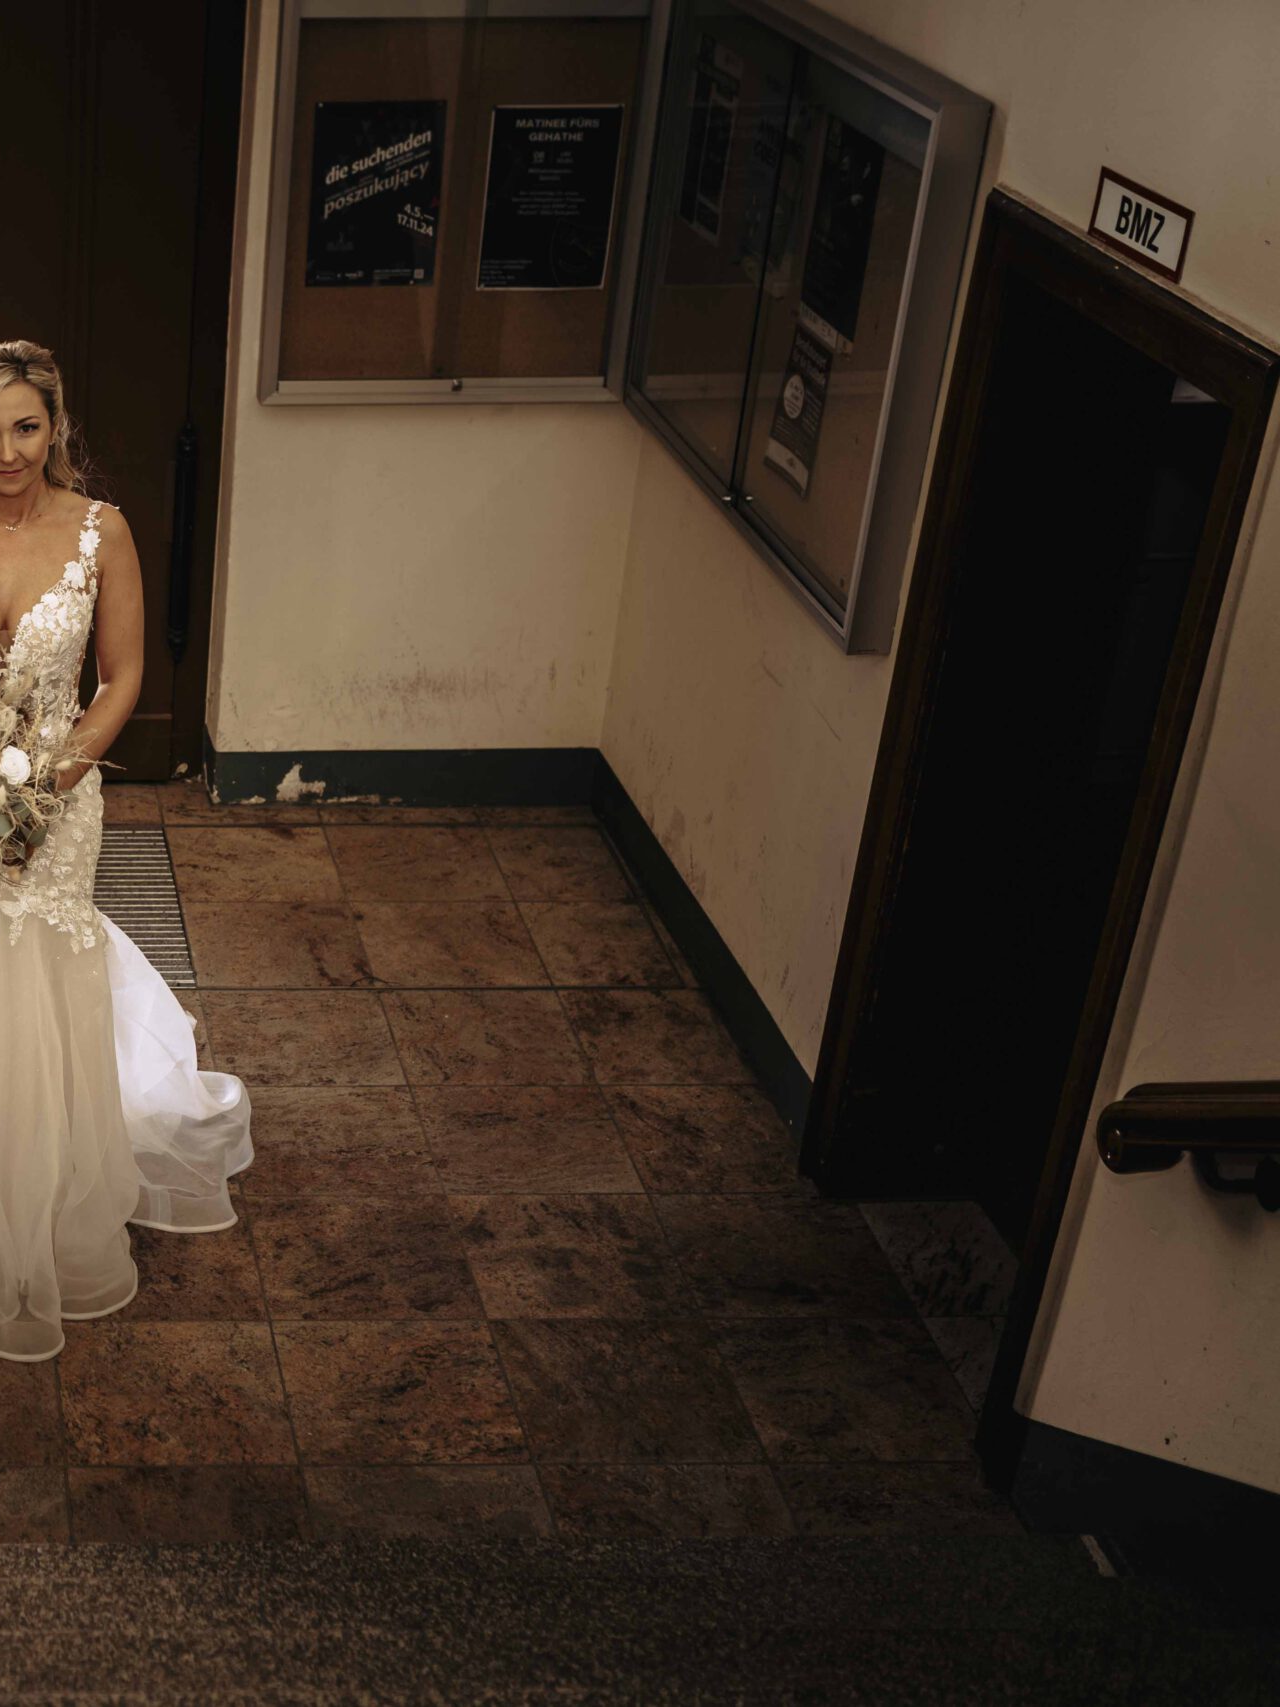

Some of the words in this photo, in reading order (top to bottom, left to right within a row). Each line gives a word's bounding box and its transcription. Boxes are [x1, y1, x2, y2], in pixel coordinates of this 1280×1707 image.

[515, 118, 568, 128] MATINEE
[569, 116, 600, 128] FÜRS
[528, 131, 584, 142] GEHATHE
[325, 164, 349, 185] die
[351, 130, 431, 174] suchenden
[324, 160, 430, 219] poszukujący
[397, 213, 433, 237] 17.11.24
[1115, 195, 1165, 253] BMZ
